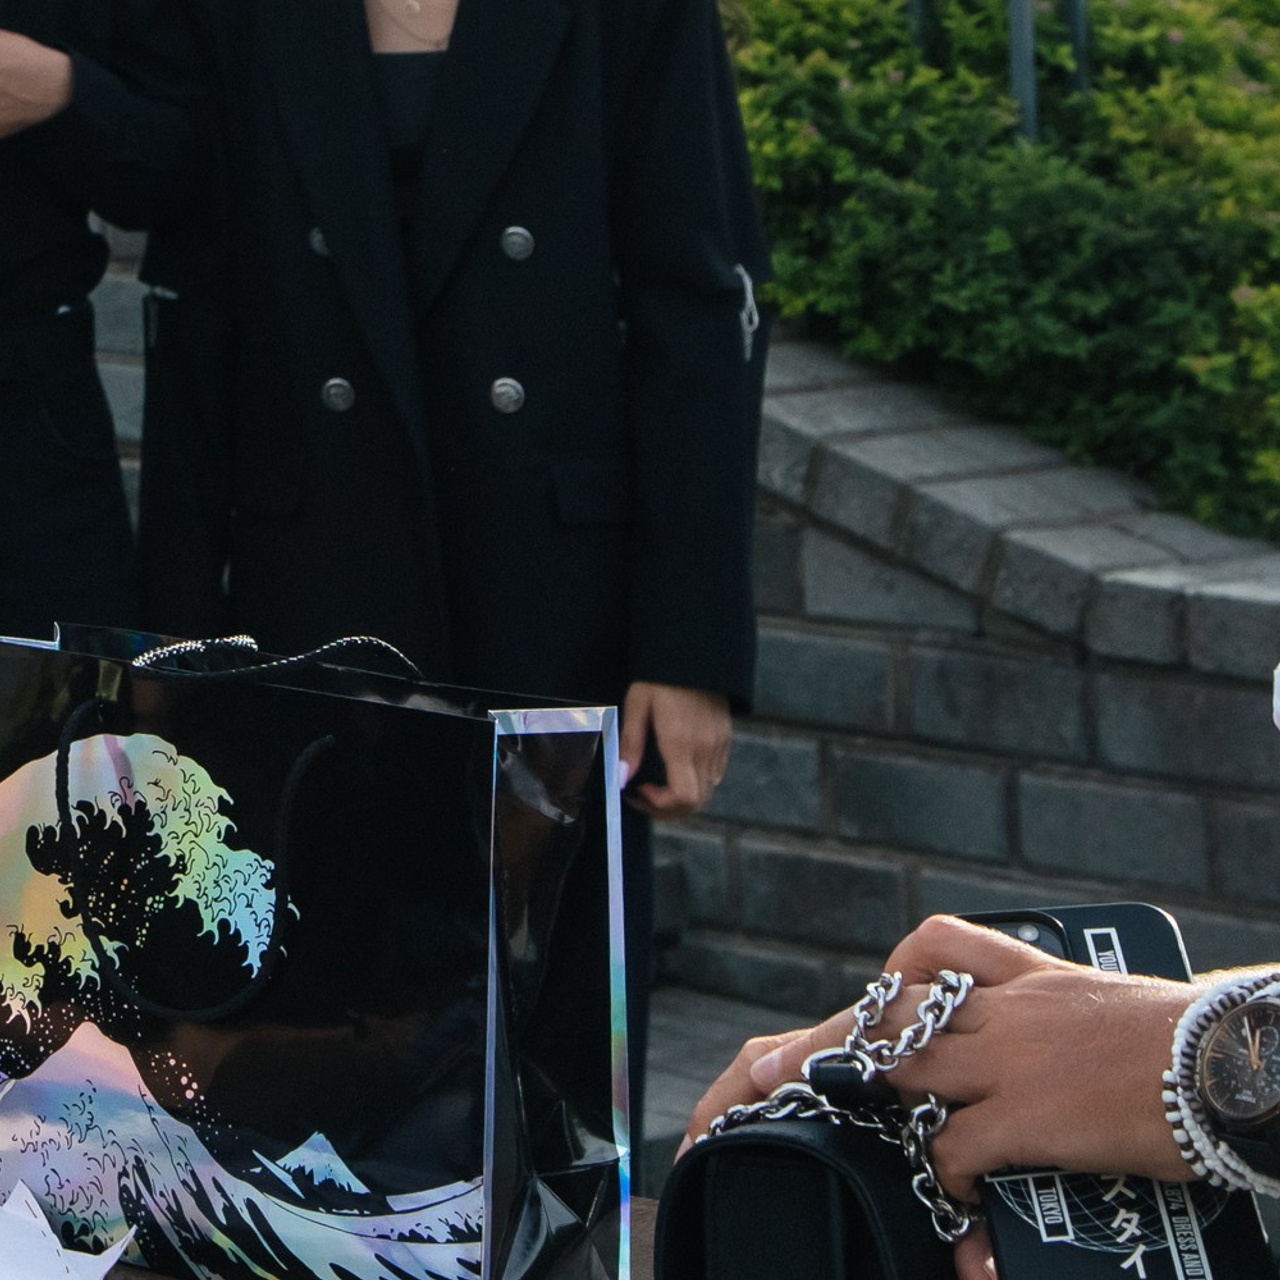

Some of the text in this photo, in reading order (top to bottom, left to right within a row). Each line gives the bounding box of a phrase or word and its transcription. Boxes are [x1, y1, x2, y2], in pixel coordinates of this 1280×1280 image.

[1037, 1186, 1064, 1224] TOKYO
[1171, 1215, 1198, 1251] DRESS
[1181, 1253, 1204, 1276] AND
